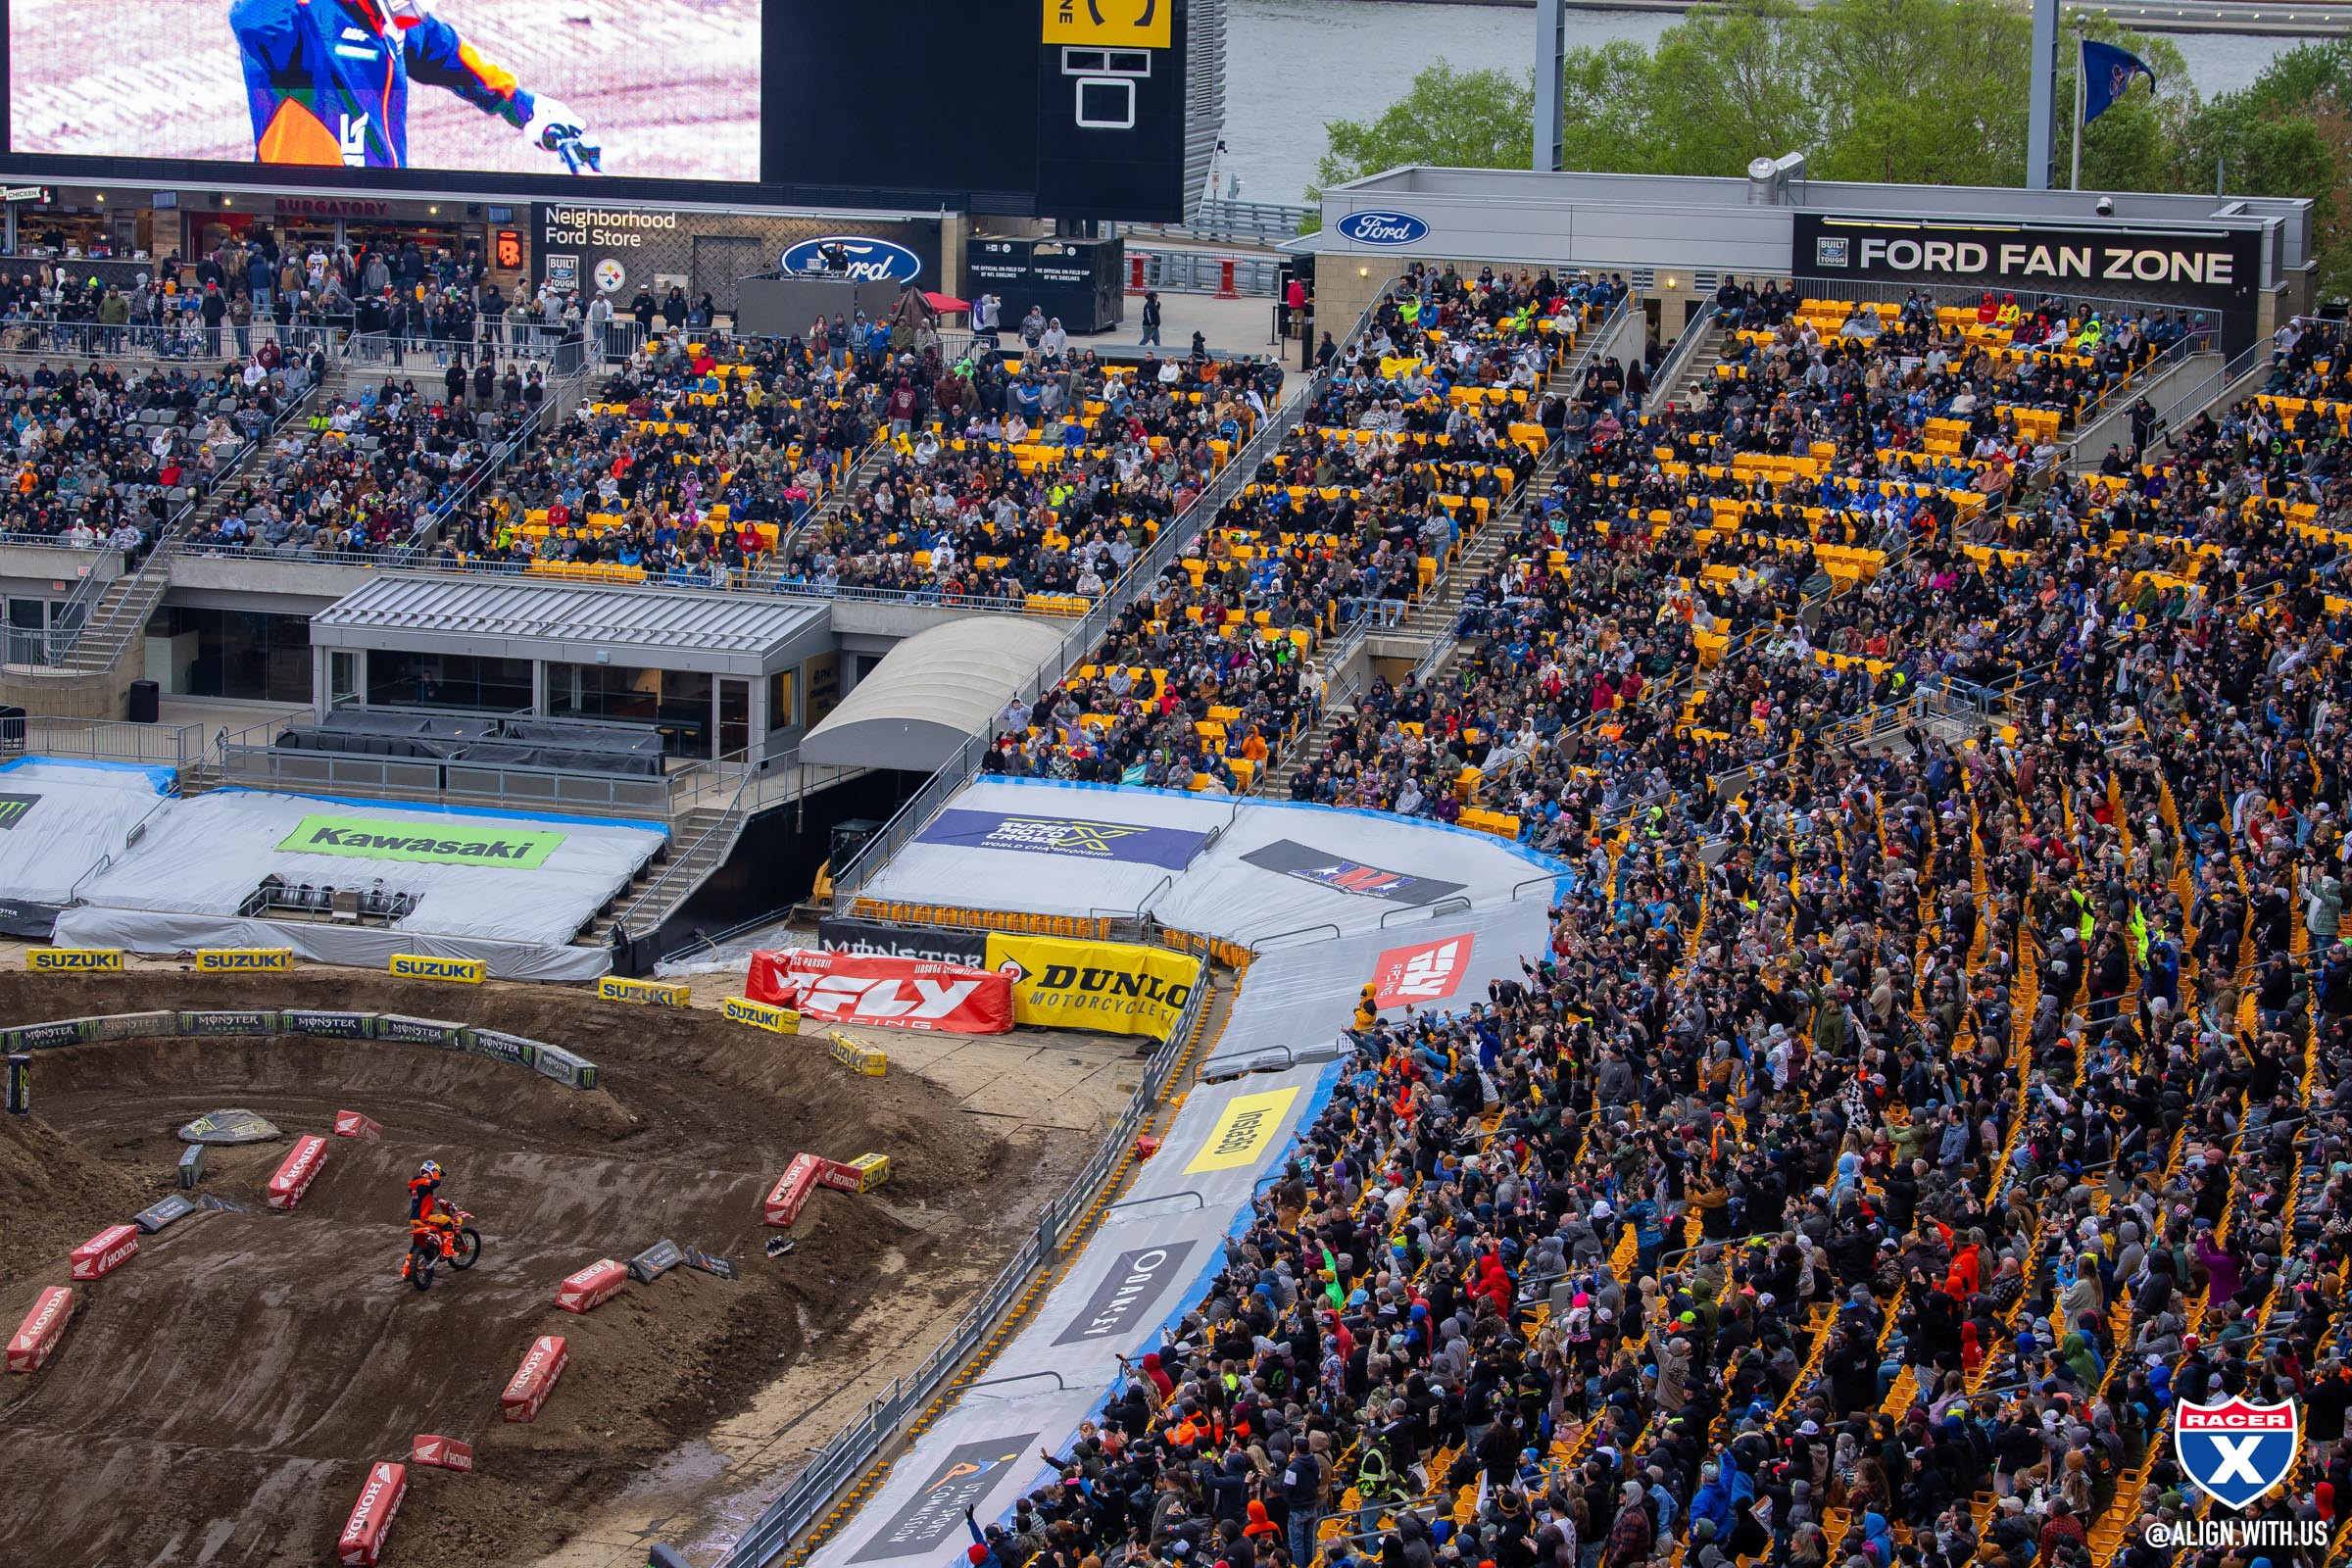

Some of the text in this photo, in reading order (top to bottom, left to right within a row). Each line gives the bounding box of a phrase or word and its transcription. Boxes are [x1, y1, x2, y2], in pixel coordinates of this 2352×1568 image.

[275, 199, 388, 215] BURGATORY
[546, 207, 676, 228] Neighborhood
[1354, 215, 1411, 240] Ford
[546, 227, 641, 247] Ford Store
[1821, 240, 1845, 249] BUILT
[550, 258, 575, 269] BUILT
[817, 243, 894, 280] Frd
[1860, 239, 2233, 284] FORD FAN ZONE
[551, 279, 575, 288] TOUGH
[995, 827, 1066, 838] MOTO
[999, 821, 1074, 833] SUPER
[309, 827, 535, 858] Kawasaki
[986, 833, 1060, 844] CROSS
[980, 841, 1114, 858] WORLD CHAMPIONSHIP
[36, 954, 118, 968] SUZUKI
[203, 954, 286, 968] SUZUKI
[396, 959, 474, 978] SUZUKI
[603, 983, 673, 1004] SUZUKI
[1037, 964, 1191, 1009] DUNLO
[1029, 992, 1156, 1016] MOTORCYCLE
[104, 1018, 159, 1030] MONSTER
[198, 1014, 259, 1025] MONSTER
[298, 1016, 356, 1028] MONSTER
[726, 1003, 779, 1027] SUZUKI
[24, 1026, 74, 1041] MONSTER
[393, 1023, 441, 1039] MONSTER
[478, 1037, 519, 1054] MONSTER
[543, 1054, 569, 1075] MONSTER
[1214, 1108, 1272, 1154] Insta360
[287, 1138, 322, 1178] HONDA
[832, 1173, 859, 1190] HONDA
[107, 1239, 138, 1268] HONDA
[569, 1264, 608, 1285] HONDA
[28, 1288, 67, 1336] HONDA
[510, 1351, 544, 1396] HONDA
[449, 1453, 472, 1469] HONDA
[343, 1482, 382, 1543] HONDA
[888, 1485, 956, 1543] COMMISSION
[915, 1481, 984, 1541] UTAH SPORTS
